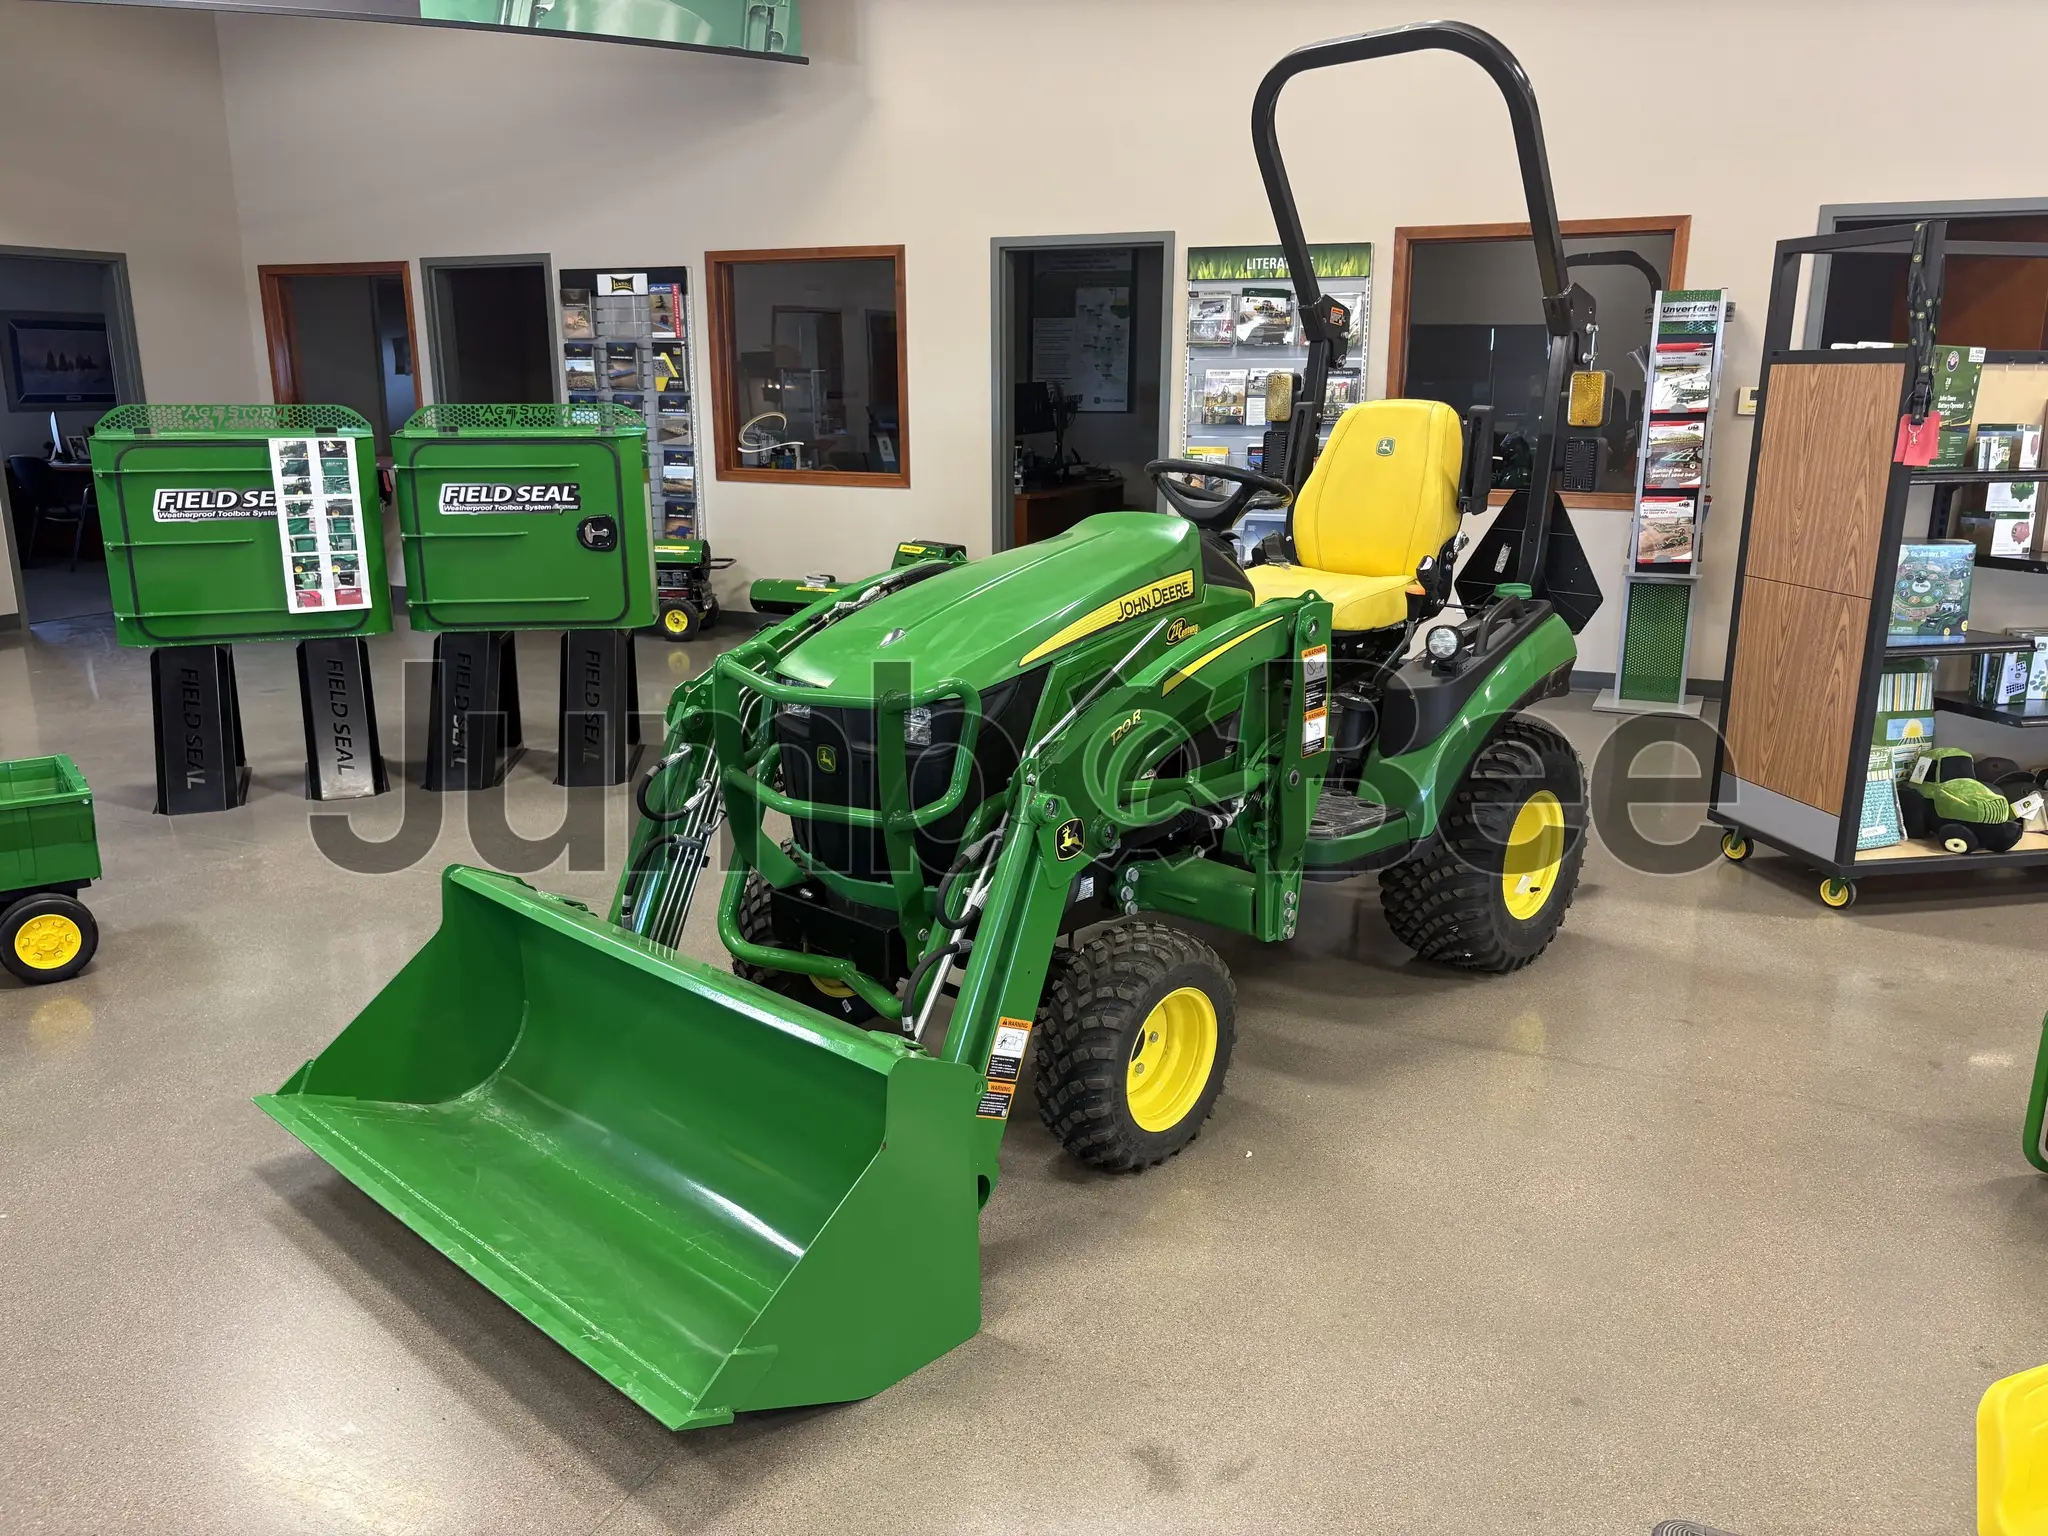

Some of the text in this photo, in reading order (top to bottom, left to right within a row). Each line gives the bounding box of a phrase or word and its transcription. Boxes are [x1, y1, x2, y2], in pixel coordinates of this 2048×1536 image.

[160, 490, 280, 509] FIELD SE
[444, 486, 513, 503] FIELD
[516, 485, 575, 502] SEAL
[158, 510, 216, 520] Weatherproof
[218, 509, 251, 518] Toolbox
[443, 503, 493, 512] Weatherproof
[494, 503, 523, 511] Toolbox
[524, 503, 552, 512] System
[1117, 580, 1190, 621] JOHN DEERE
[1307, 645, 1326, 657] WARNING
[450, 652, 472, 768] FIELD SEAL
[582, 650, 601, 764] FIELD SEAL
[1307, 709, 1326, 720] WARNING
[326, 659, 355, 776] FIELD SEAL
[180, 667, 206, 790] FIELD SEAL
[1007, 1020, 1029, 1029] WARNING
[990, 1084, 1012, 1093] WARNING
